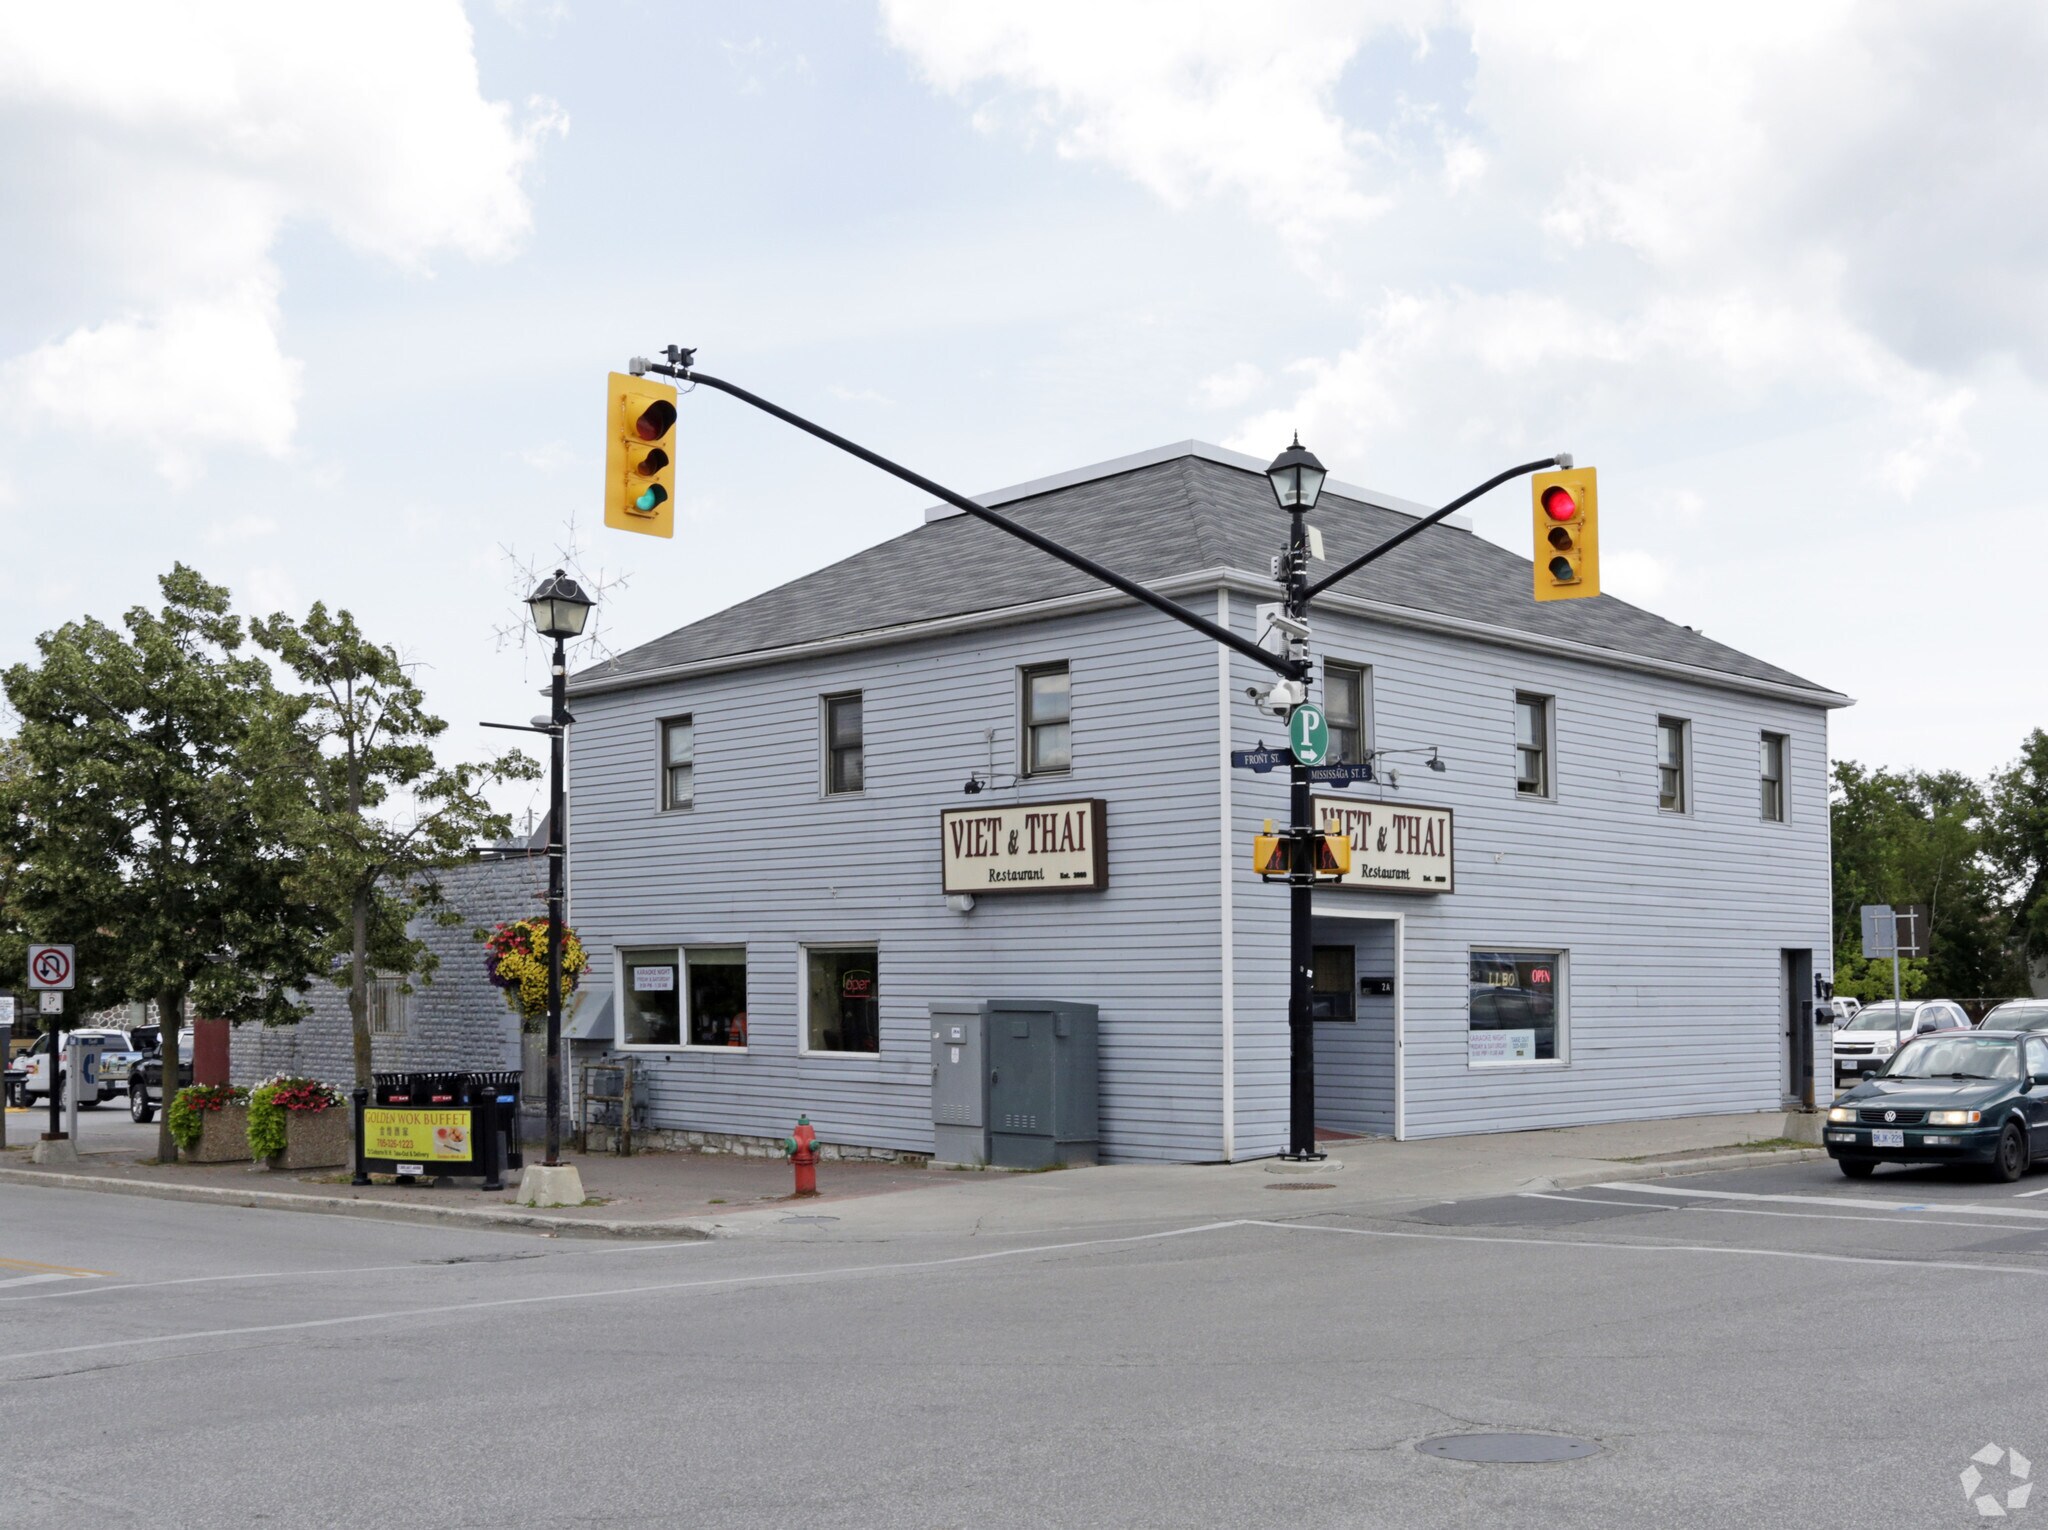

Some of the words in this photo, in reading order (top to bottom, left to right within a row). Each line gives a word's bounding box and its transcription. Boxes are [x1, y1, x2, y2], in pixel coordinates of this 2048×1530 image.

[1300, 710, 1320, 746] P
[1245, 753, 1268, 765] FRONT
[1271, 753, 1280, 764] ST.
[1311, 769, 1349, 780] MISSISSAGA
[1351, 768, 1361, 779] ST.
[950, 817, 1002, 859] VIET
[1007, 829, 1019, 855] &
[1025, 811, 1087, 854] THAI
[1321, 807, 1372, 851] ET
[1377, 826, 1388, 852] &
[1393, 814, 1446, 857] THAI
[989, 867, 1045, 882] Restaurant
[1362, 864, 1411, 880] Restaurant
[1532, 969, 1550, 983] OPEN
[1381, 982, 1391, 991] 2A
[365, 1111, 395, 1124] GOLDEN
[398, 1112, 421, 1125] WOK
[424, 1113, 467, 1125] BUFFET
